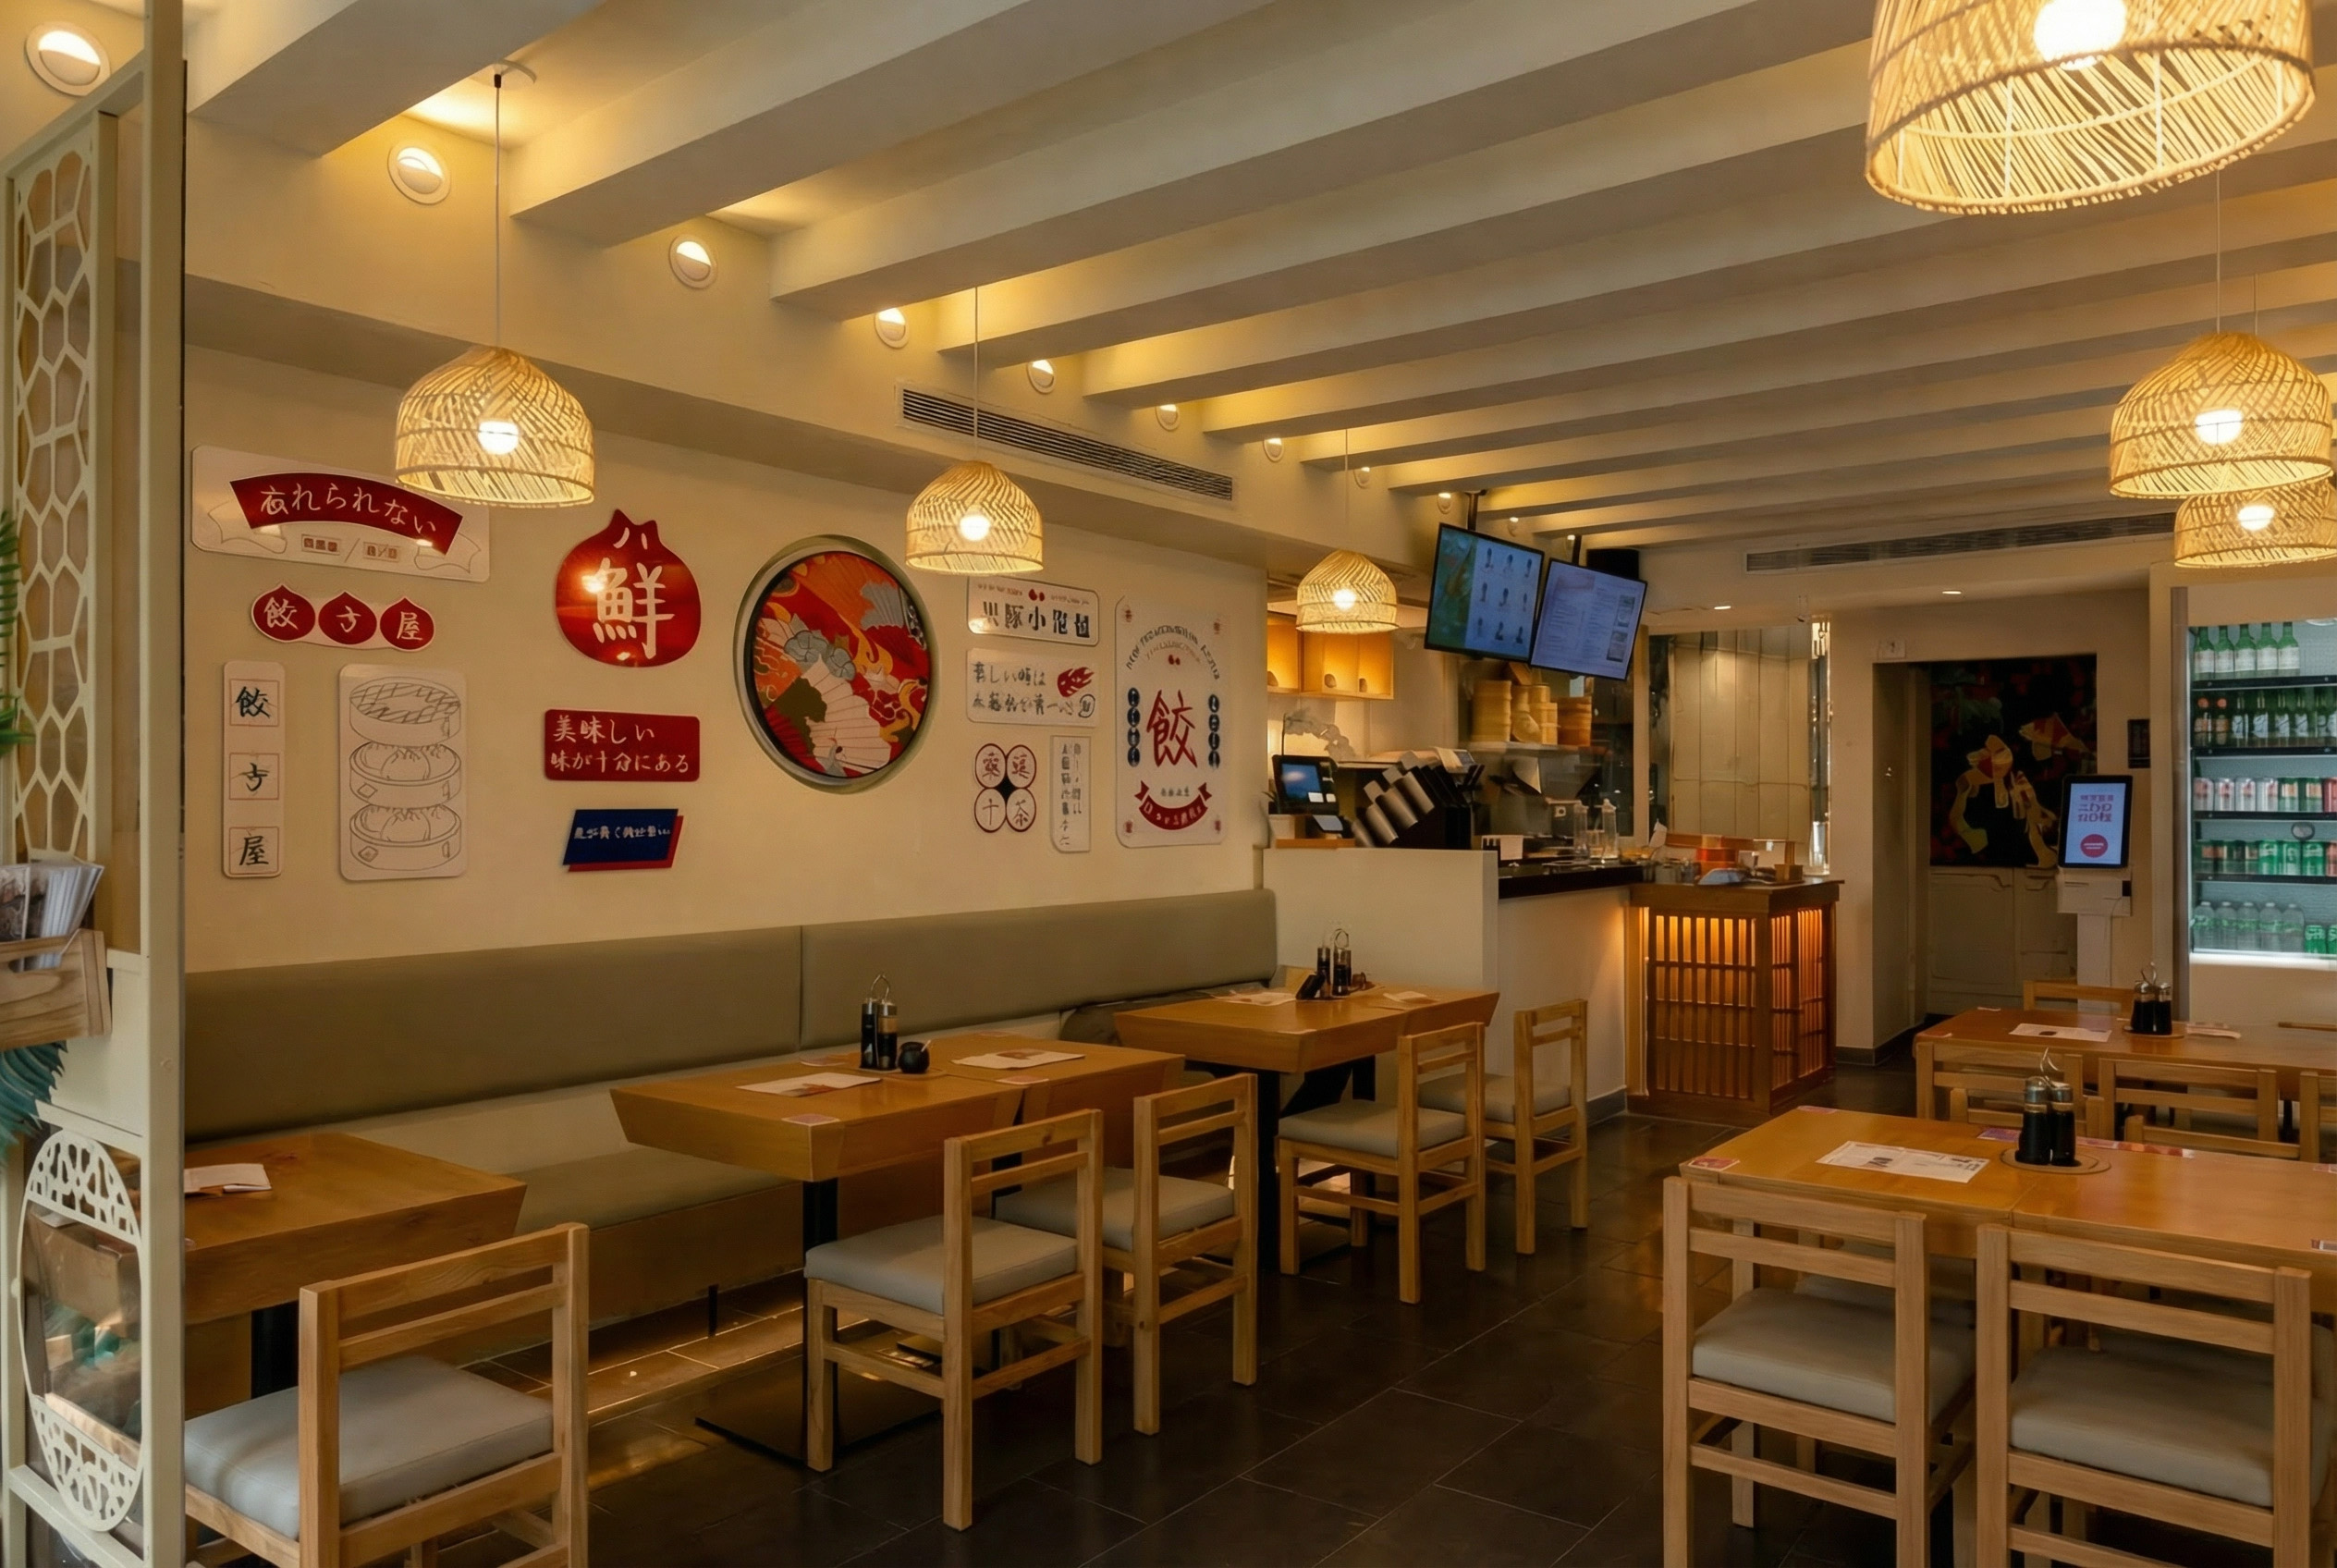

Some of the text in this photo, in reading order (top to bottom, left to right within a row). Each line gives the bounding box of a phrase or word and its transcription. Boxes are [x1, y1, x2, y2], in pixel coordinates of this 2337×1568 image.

[593, 557, 676, 659] 鮮
[553, 715, 655, 744] 美味しい
[1146, 689, 1198, 768] 餃
